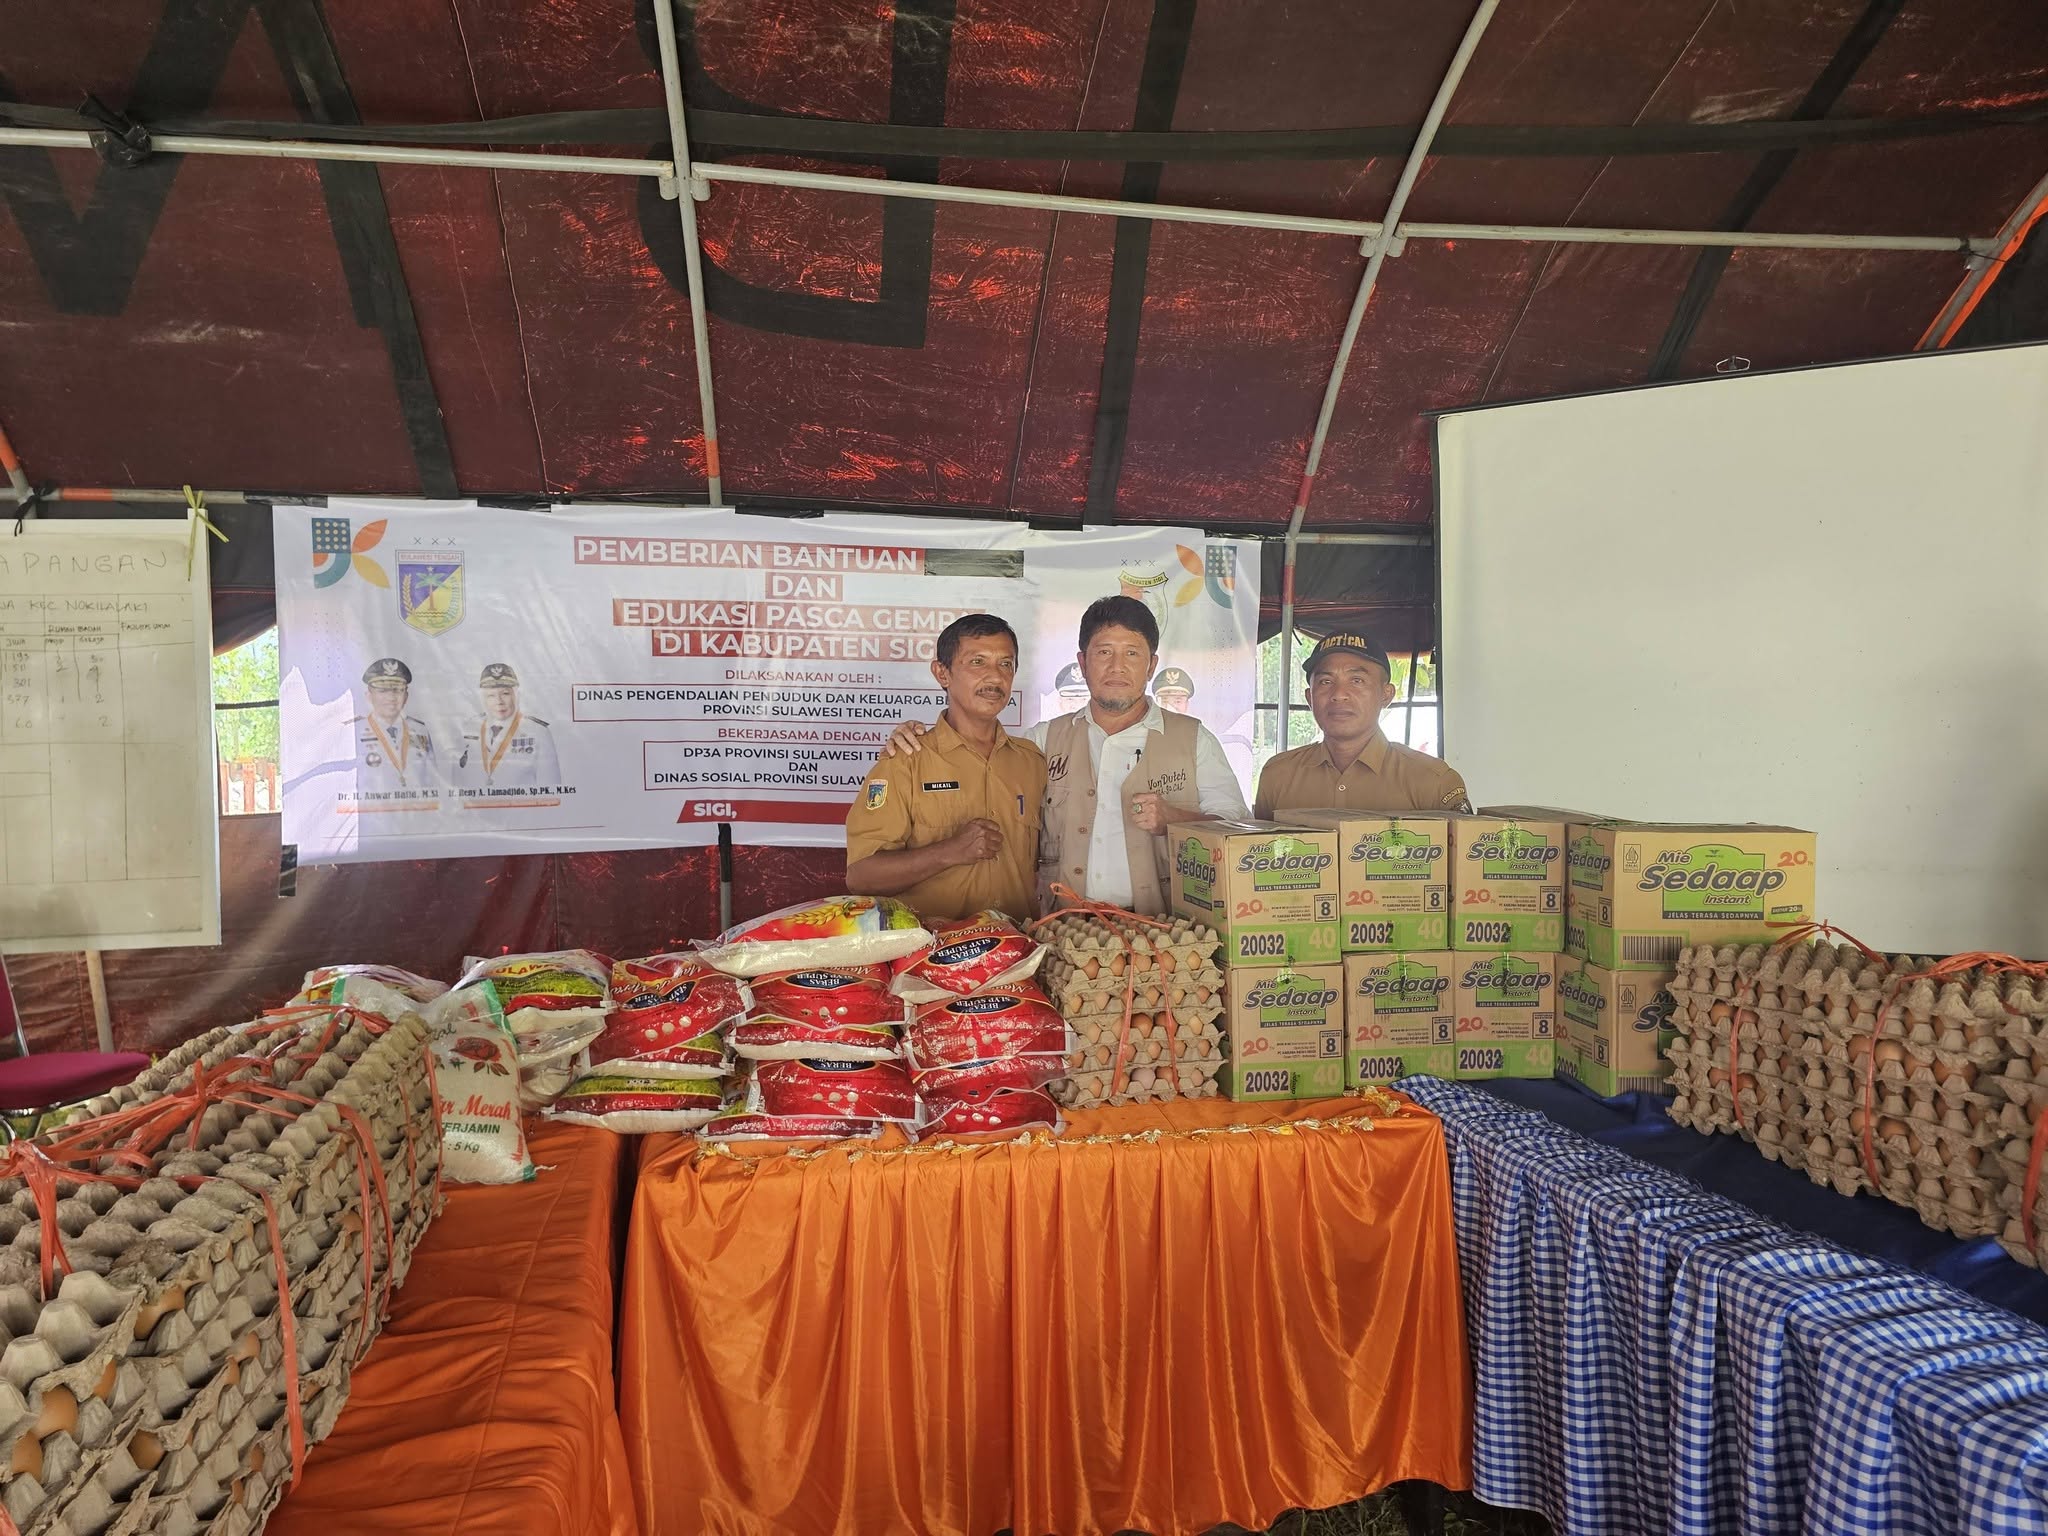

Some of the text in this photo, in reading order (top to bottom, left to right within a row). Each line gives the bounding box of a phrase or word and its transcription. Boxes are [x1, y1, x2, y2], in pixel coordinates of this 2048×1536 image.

[577, 539, 917, 571] PEMBERIAN BANTUAN
[772, 575, 836, 599] DAN
[623, 602, 974, 632] EDUKASI PASCA GEMP
[659, 633, 936, 660] DI KABUPATEN SIG
[1320, 633, 1368, 651] TACTICAL
[725, 669, 833, 683] DILAKSANAKAN
[838, 673, 874, 684] OLEH
[577, 690, 622, 701] DINAS
[627, 690, 739, 701] PENGENDALIAN
[743, 691, 821, 703] PENDUDUK
[826, 693, 856, 704] DAN
[860, 694, 931, 705] KELUARGA
[703, 704, 902, 719] PROVINSI SULAWESI TENGAH
[718, 728, 819, 740] BEKERJASAMA
[823, 731, 881, 742] DENGAN
[684, 747, 721, 758] DP3A
[725, 747, 789, 759] PROVINSI
[793, 749, 862, 761] SULAWESI
[789, 762, 818, 772] DAN
[654, 773, 698, 783] DINAS
[701, 772, 750, 783] SOSIAL
[754, 773, 818, 785] PROVINSI
[821, 775, 866, 786] SULAW
[556, 786, 577, 795] M.Kes
[693, 803, 737, 819] SIGI,
[1361, 833, 1384, 843] Mie
[1479, 832, 1502, 842] Mie
[1249, 845, 1272, 854] Mie
[1657, 850, 1693, 865] Mie
[1237, 852, 1333, 873] Sedaap
[1777, 851, 1807, 867] 20
[1177, 852, 1216, 888] Sedaap
[1637, 863, 1787, 897] Sedaap
[1345, 889, 1374, 906] 20
[1431, 892, 1440, 907] 8
[1462, 888, 1491, 905] 20
[1546, 893, 1556, 908] 8
[1703, 893, 1753, 906] Instant
[1235, 899, 1263, 919] 20
[1321, 901, 1331, 916] 8
[1350, 921, 1394, 944] 20032
[1466, 921, 1510, 943] 20032
[937, 944, 968, 957] SUPER
[1240, 934, 1285, 956] 20032
[951, 947, 981, 960] BERAS
[1369, 967, 1391, 976] Mie
[1472, 962, 1494, 970] Mie
[1256, 980, 1277, 989] Mie
[1357, 974, 1450, 996] Sedaap
[1460, 968, 1552, 992] Sedaap
[1243, 987, 1339, 1010] Sedaap
[1558, 980, 1606, 1012] Sedaap
[1439, 1024, 1448, 1038] 8
[1456, 1016, 1483, 1033] 20
[1539, 1020, 1549, 1034] 8
[1355, 1025, 1382, 1042] 20
[1242, 1037, 1268, 1057] 20
[1326, 1038, 1336, 1052] 8
[1360, 1056, 1404, 1078] 20032
[1460, 1049, 1503, 1069] 20032
[1245, 1070, 1289, 1093] 20032
[459, 1094, 511, 1120] Merah
[454, 1142, 462, 1151] 5
[464, 1142, 480, 1154] Kg
